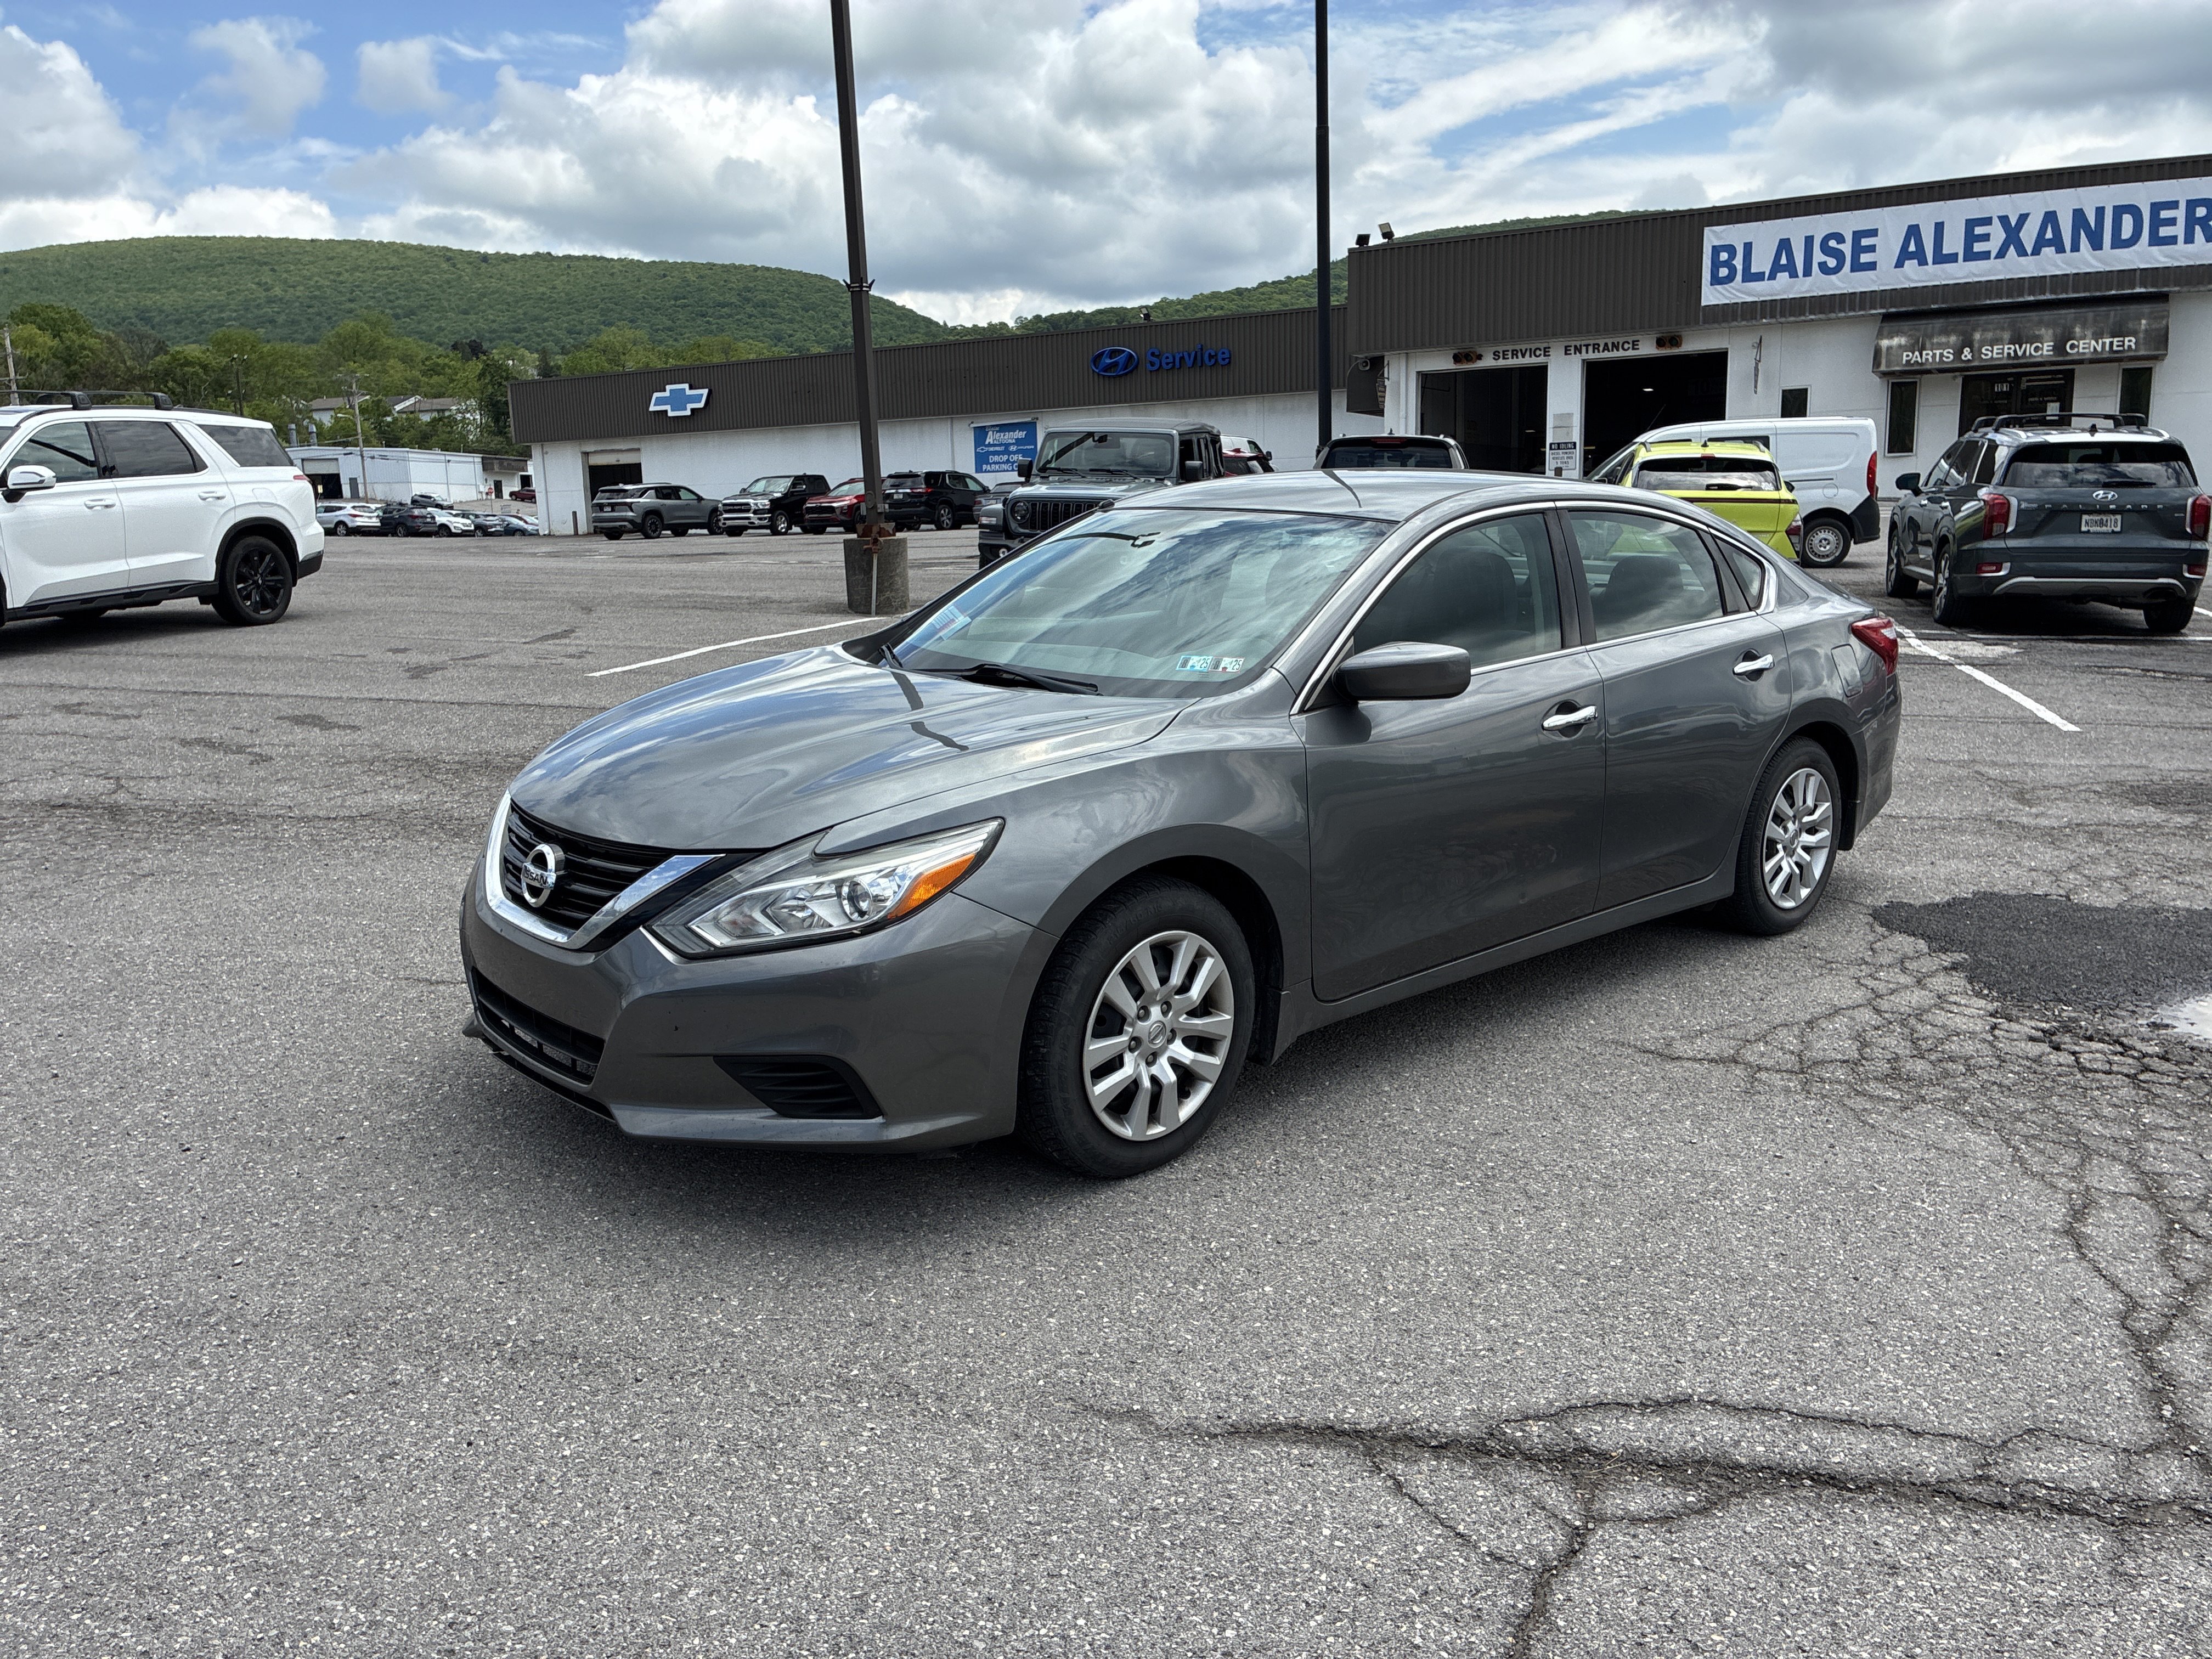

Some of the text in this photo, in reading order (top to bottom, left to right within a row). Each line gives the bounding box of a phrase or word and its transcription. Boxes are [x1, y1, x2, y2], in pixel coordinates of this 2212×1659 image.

[1709, 197, 2212, 286] BLAISE ALEXANDER
[1146, 343, 1231, 371] Service
[1492, 340, 1640, 361] SERVICE ENTRANCE
[1902, 336, 2136, 365] PARTS & SERVICE CENTER
[985, 430, 1028, 445] Alexander
[989, 454, 1023, 463] DROP OFF
[982, 463, 1012, 472] PARKING
[1199, 658, 1210, 669] 25
[1231, 659, 1243, 670] 25
